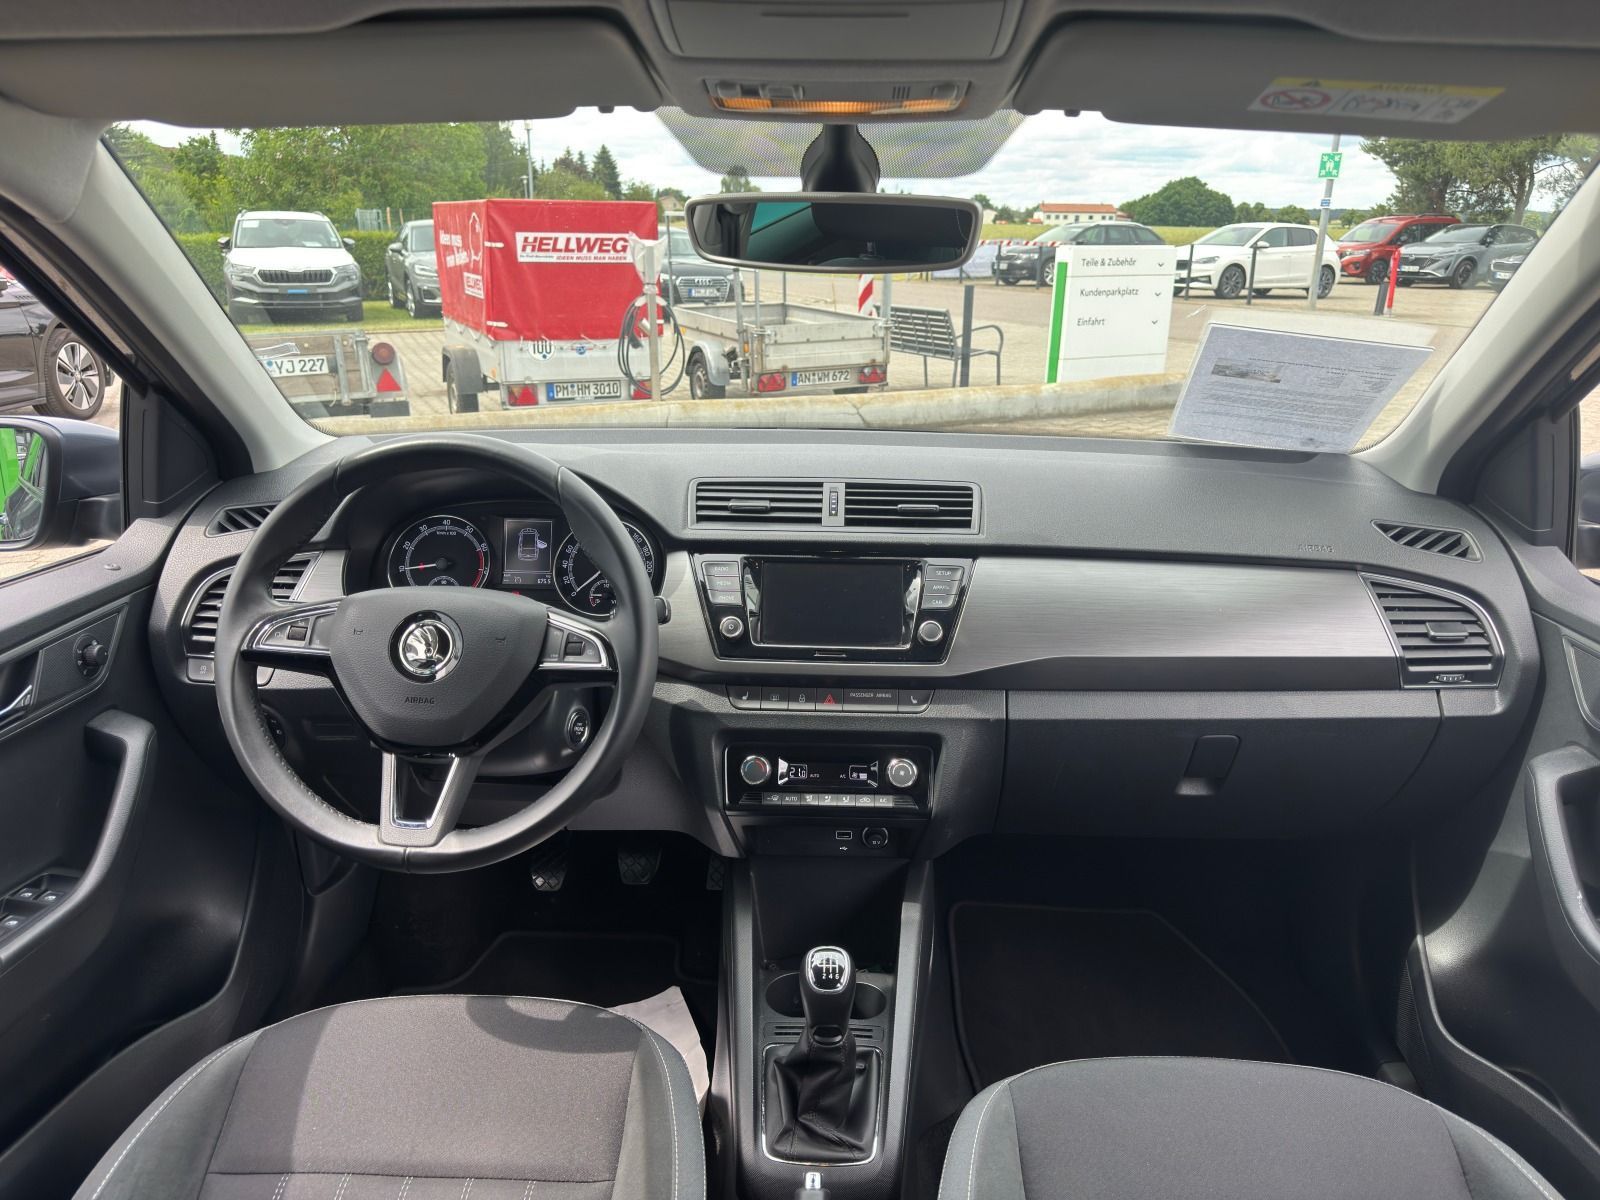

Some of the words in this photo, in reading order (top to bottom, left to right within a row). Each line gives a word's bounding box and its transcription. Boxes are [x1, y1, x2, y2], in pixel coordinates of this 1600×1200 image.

[521, 236, 629, 254] HELLWEG
[1081, 258, 1099, 267] Teile
[1100, 258, 1106, 267] &
[1107, 257, 1137, 267] Zubehör
[1080, 287, 1139, 298] Kundenparkplatz
[1077, 317, 1105, 327] Einfahrt
[299, 358, 325, 373] 227
[798, 372, 811, 384] AN
[832, 370, 850, 381] 672
[555, 384, 569, 397] PM
[577, 384, 591, 396] HM
[593, 382, 618, 395] 3010
[418, 524, 428, 533] 30
[465, 525, 474, 534] 50
[632, 532, 643, 543] 160
[402, 540, 411, 550] 20
[480, 543, 488, 552] 60
[565, 544, 574, 554] 60
[642, 546, 651, 557] 180
[561, 560, 569, 569] 40
[646, 560, 654, 573] 200
[563, 576, 572, 585] 20
[405, 696, 435, 704] AIRBAG
